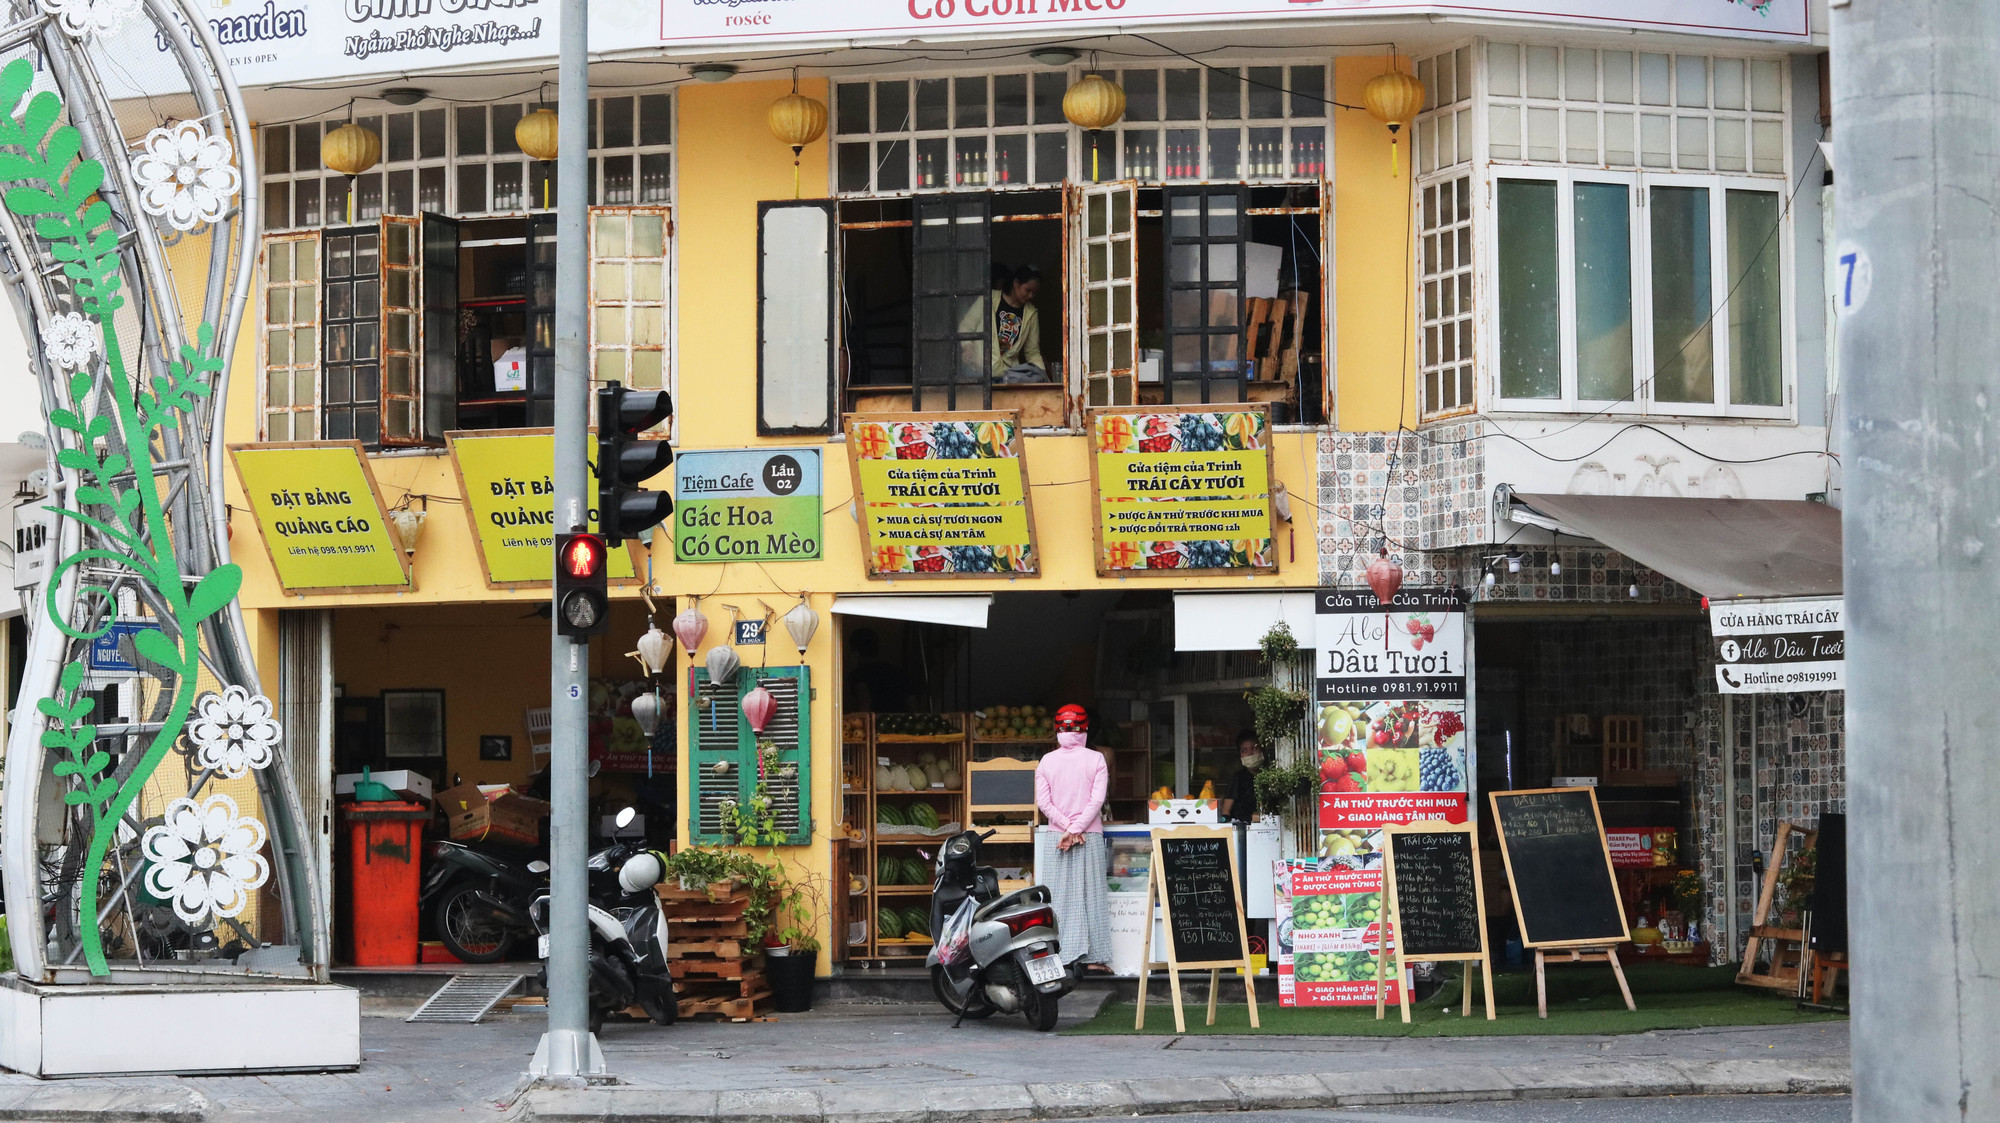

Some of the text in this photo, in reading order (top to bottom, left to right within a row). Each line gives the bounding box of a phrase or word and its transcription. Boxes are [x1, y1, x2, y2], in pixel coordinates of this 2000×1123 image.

[725, 10, 772, 26] rosée
[155, 1, 307, 51] aarden
[344, 29, 393, 60] Ngắm
[394, 25, 429, 51] Phố
[428, 24, 474, 52] Nghe
[244, 55, 252, 64] IS
[255, 53, 278, 64] OPEN
[1840, 252, 1857, 307] 7
[771, 463, 795, 477] Lầu
[887, 467, 996, 482] Cửa tiệm của Trinh
[1128, 460, 1242, 475] Cửa tiệm của Trinh
[490, 475, 555, 497] ĐẶT BẢ
[682, 472, 754, 493] Tiệm Cafe
[888, 481, 1000, 497] TRÁI CÂY TƯƠI
[1127, 475, 1245, 491] TRÁI CÂY TƯƠI
[271, 487, 351, 508] ĐẶT BẢNG
[682, 505, 773, 528] Gác Hoa
[886, 513, 1003, 526] MUA CẢ SỰ TƯƠI NGON
[1118, 508, 1264, 522] ĐƯỢC ĂN THỬ TRƯỚC KHI MUA
[275, 514, 370, 537] QUẢNG CÁO
[1119, 522, 1241, 535] ĐƯỢC ĐỔI TRẢ TRONG 12h
[889, 528, 986, 541] MUA CẢ SỰ AN TÂM
[287, 544, 376, 556] Liên hệ 098.191.9911
[501, 538, 523, 548] Liên
[525, 537, 539, 548] hệ
[682, 532, 816, 556] Có Con Mèo
[1325, 593, 1459, 609] Cửa Tiệ Của Trinh
[1720, 609, 1840, 628] CỬA HÀNG TRÁI CÂY
[742, 623, 758, 638] 29
[1336, 615, 1386, 646] Alo
[1741, 638, 1768, 659] Alo
[1774, 636, 1807, 659] Dâu
[1328, 648, 1453, 674] Dâu Tươi
[1744, 671, 1784, 685] Hotline
[570, 686, 579, 697] 5
[1326, 682, 1459, 694] Hotline 0981.91.9911
[1333, 796, 1458, 809] ĂN THỬ TRƯỚC KHI MUA
[1348, 813, 1373, 822] GIAO
[1375, 811, 1403, 822] HÀNG
[1427, 812, 1446, 821] NƠI
[1303, 872, 1378, 883] ĂN THỬ TRƯỚC KHI
[1303, 879, 1375, 892] ĐƯỢC CHỌN TỪNG
[1318, 931, 1341, 939] XANH
[1035, 967, 1061, 982] 3239
[1336, 985, 1359, 993] HÀNG
[1360, 984, 1376, 994] TẬN
[1337, 993, 1352, 1001] TRẢ
[1353, 991, 1373, 1001] MIỄN
